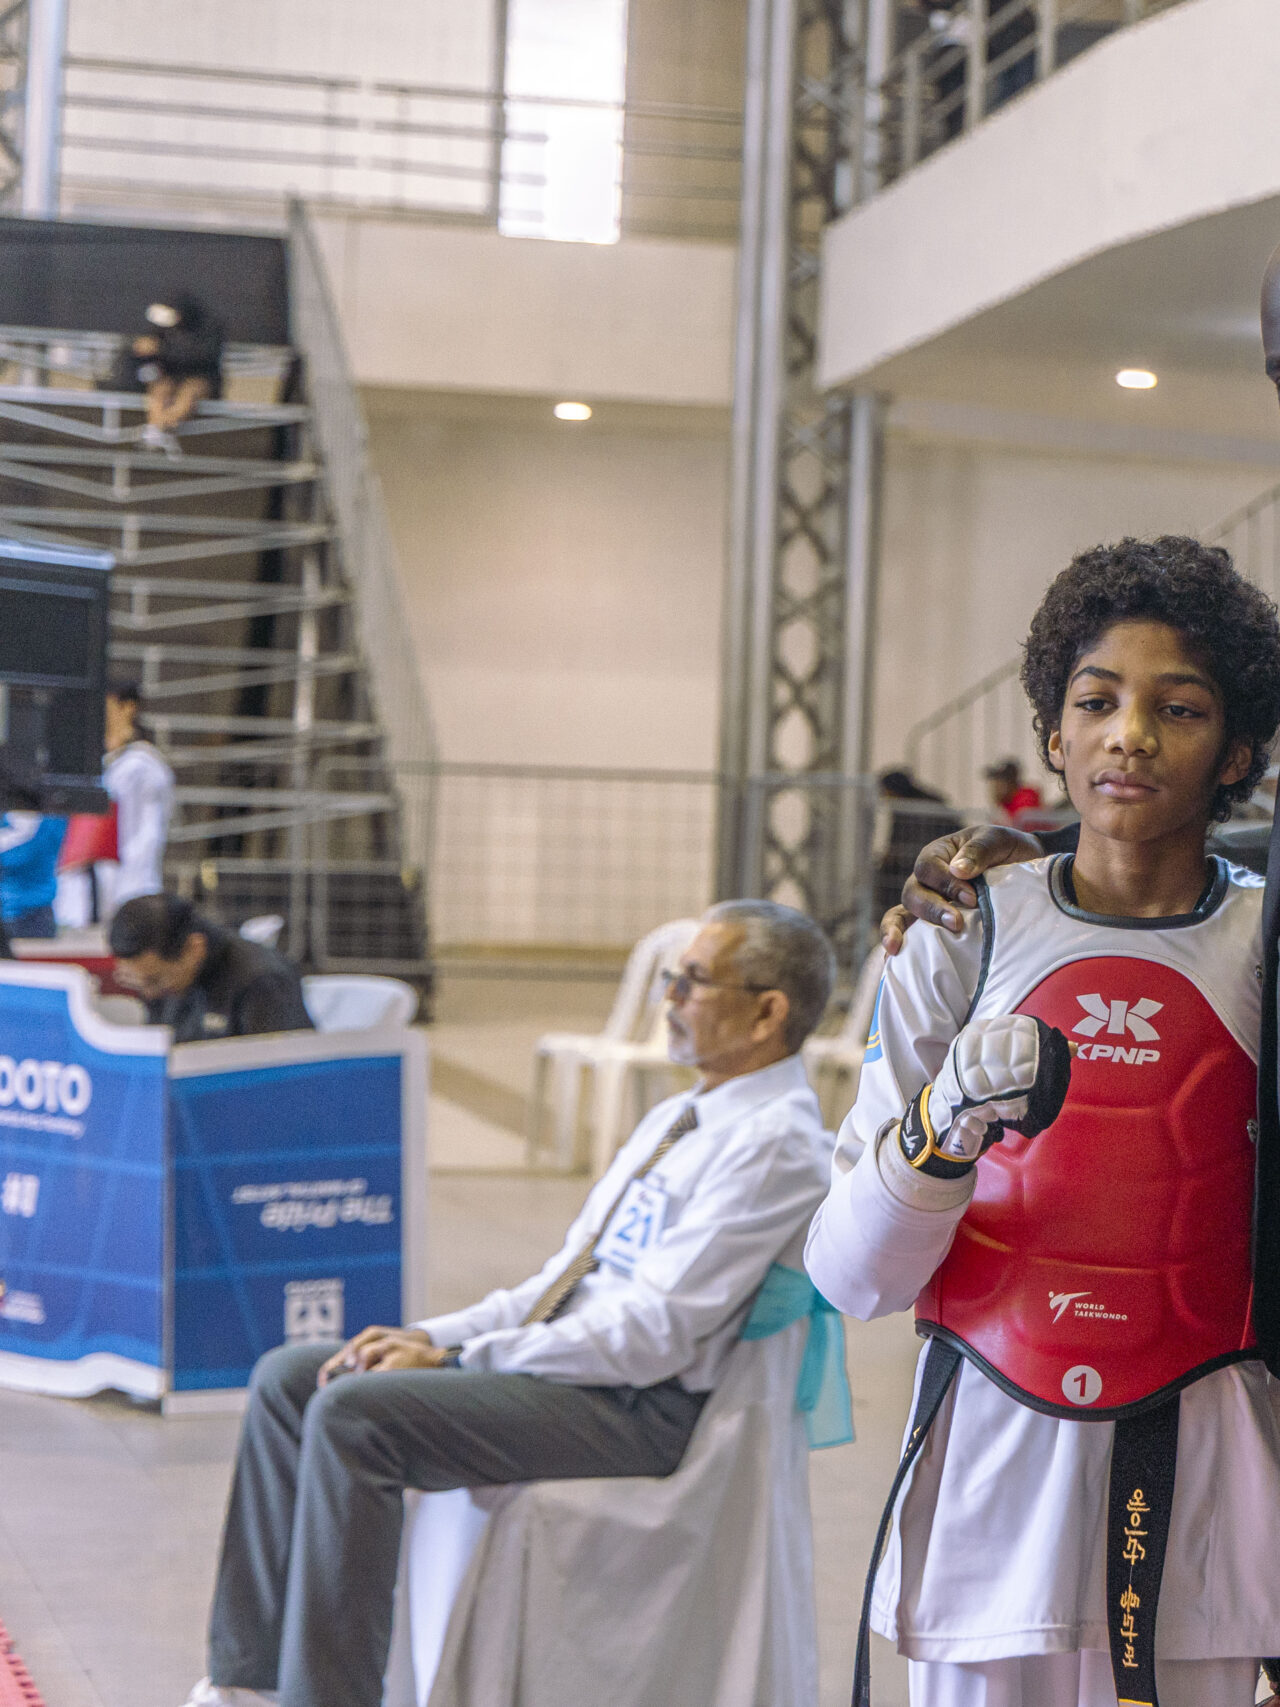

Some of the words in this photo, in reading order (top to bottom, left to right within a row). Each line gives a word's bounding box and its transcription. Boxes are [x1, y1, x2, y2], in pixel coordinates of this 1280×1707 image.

[616, 1206, 652, 1248] 21
[1074, 1302, 1105, 1310] WORLD
[1074, 1310, 1128, 1321] TAEKWONDO
[1073, 1373, 1087, 1397] 1
